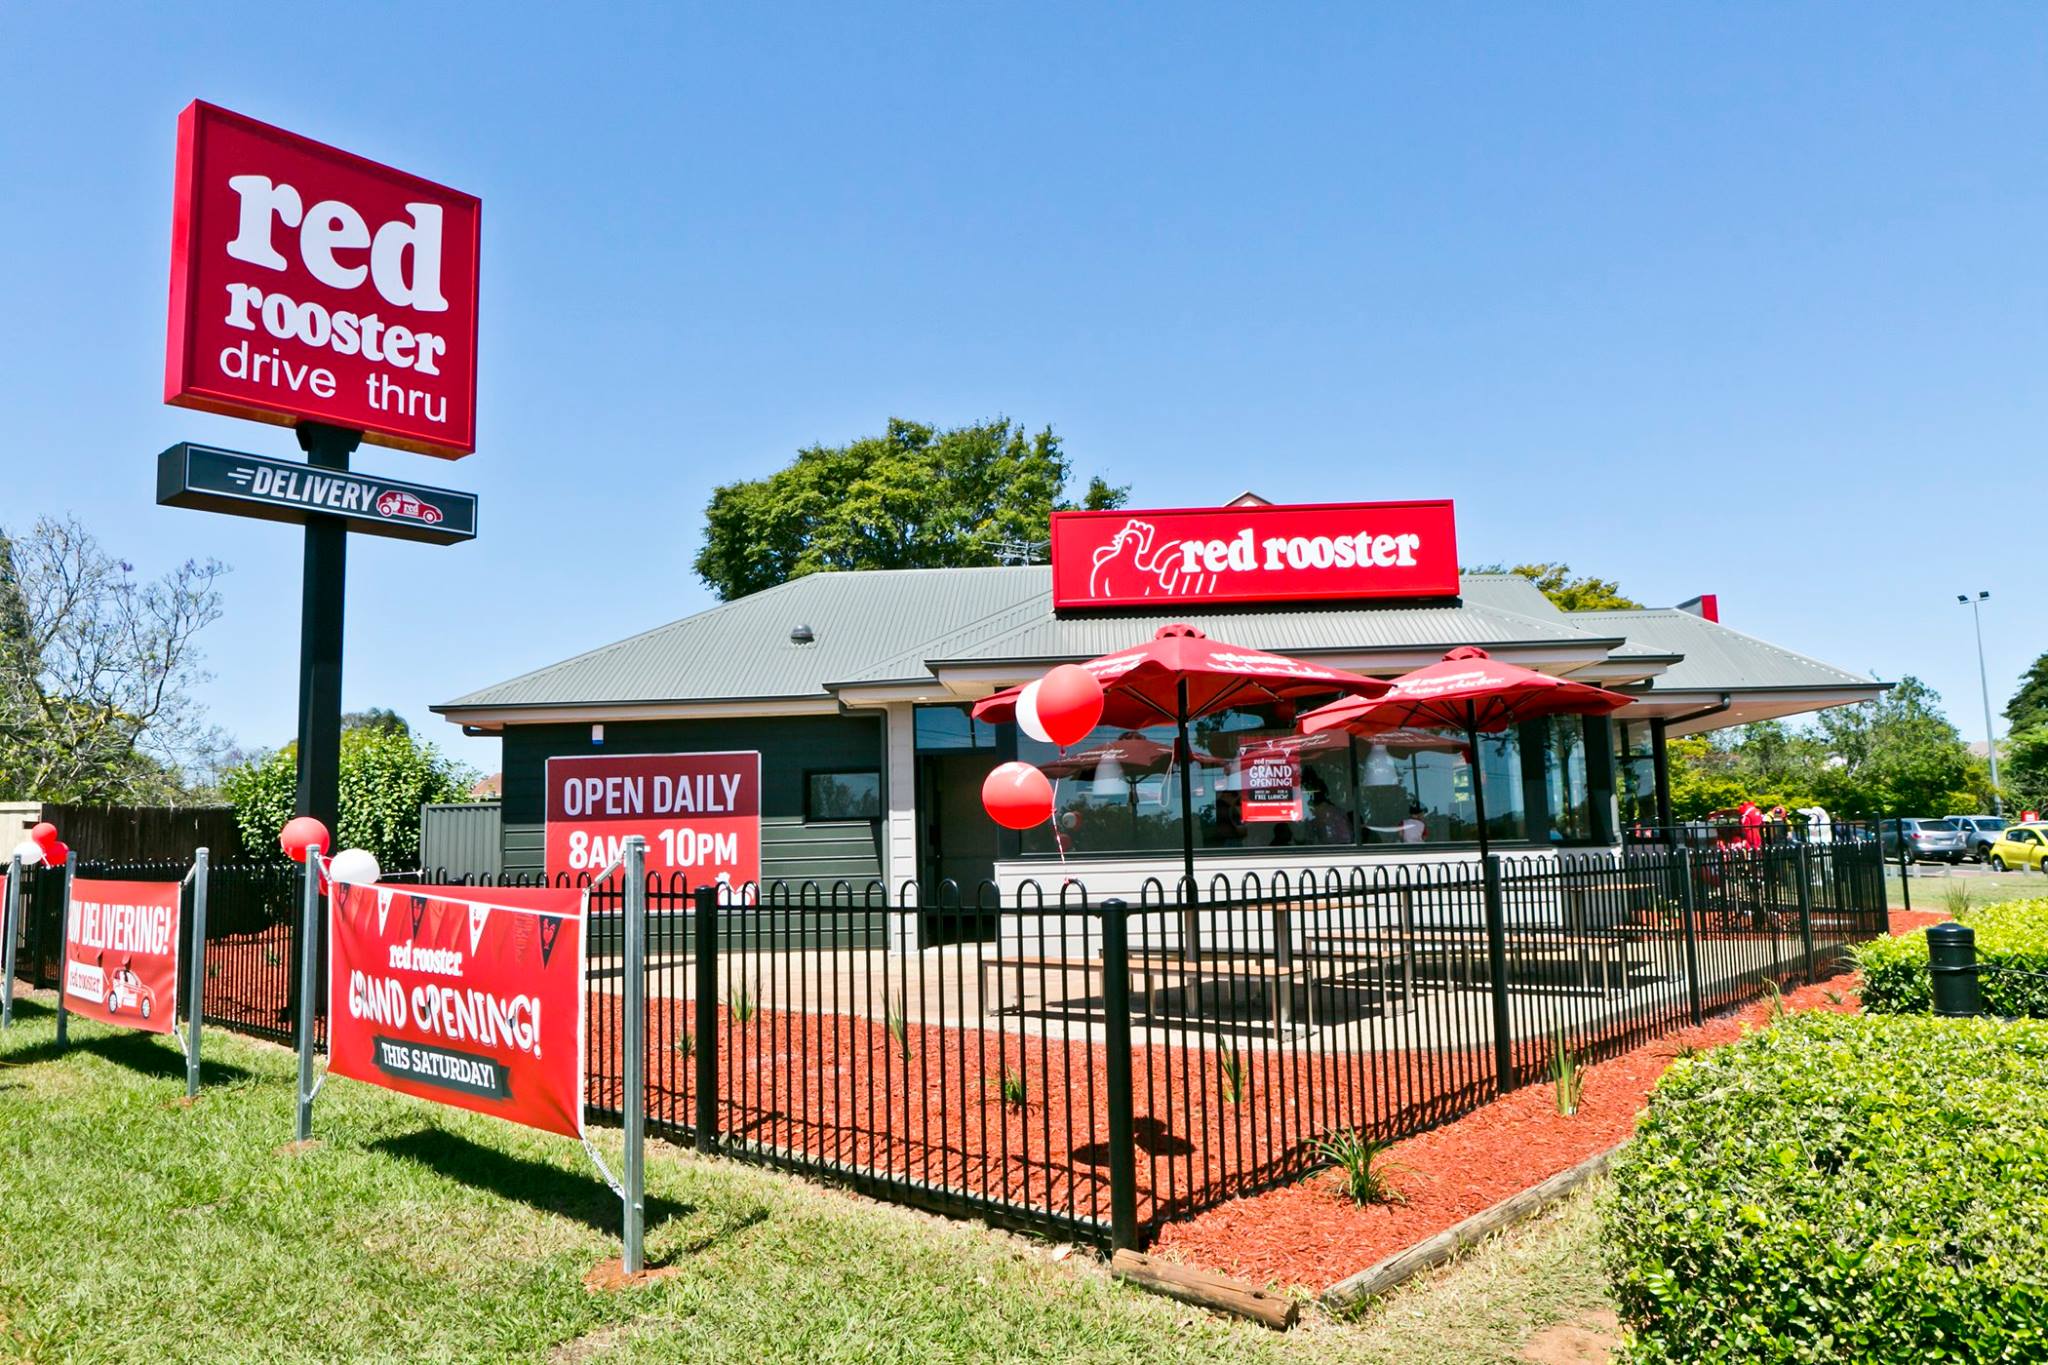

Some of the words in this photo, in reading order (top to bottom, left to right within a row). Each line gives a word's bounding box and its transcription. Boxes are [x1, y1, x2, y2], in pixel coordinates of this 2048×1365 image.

[226, 175, 448, 312] red
[225, 283, 446, 376] rooster
[219, 341, 336, 398] drive
[365, 373, 447, 423] thru
[252, 466, 378, 512] DELIVERY
[1179, 528, 1257, 573] red
[1263, 530, 1420, 571] rooster
[1249, 765, 1292, 778] GRAND
[1250, 777, 1292, 787] OPENING!
[563, 776, 644, 816] OPEN
[653, 774, 742, 813] DAILY
[658, 828, 737, 867] 10PM
[82, 902, 171, 955] DELIVERING!
[389, 939, 412, 970] red
[412, 984, 543, 1058] OPENING!
[381, 1042, 411, 1070] THIS
[412, 1051, 496, 1090] SATURDAY!
